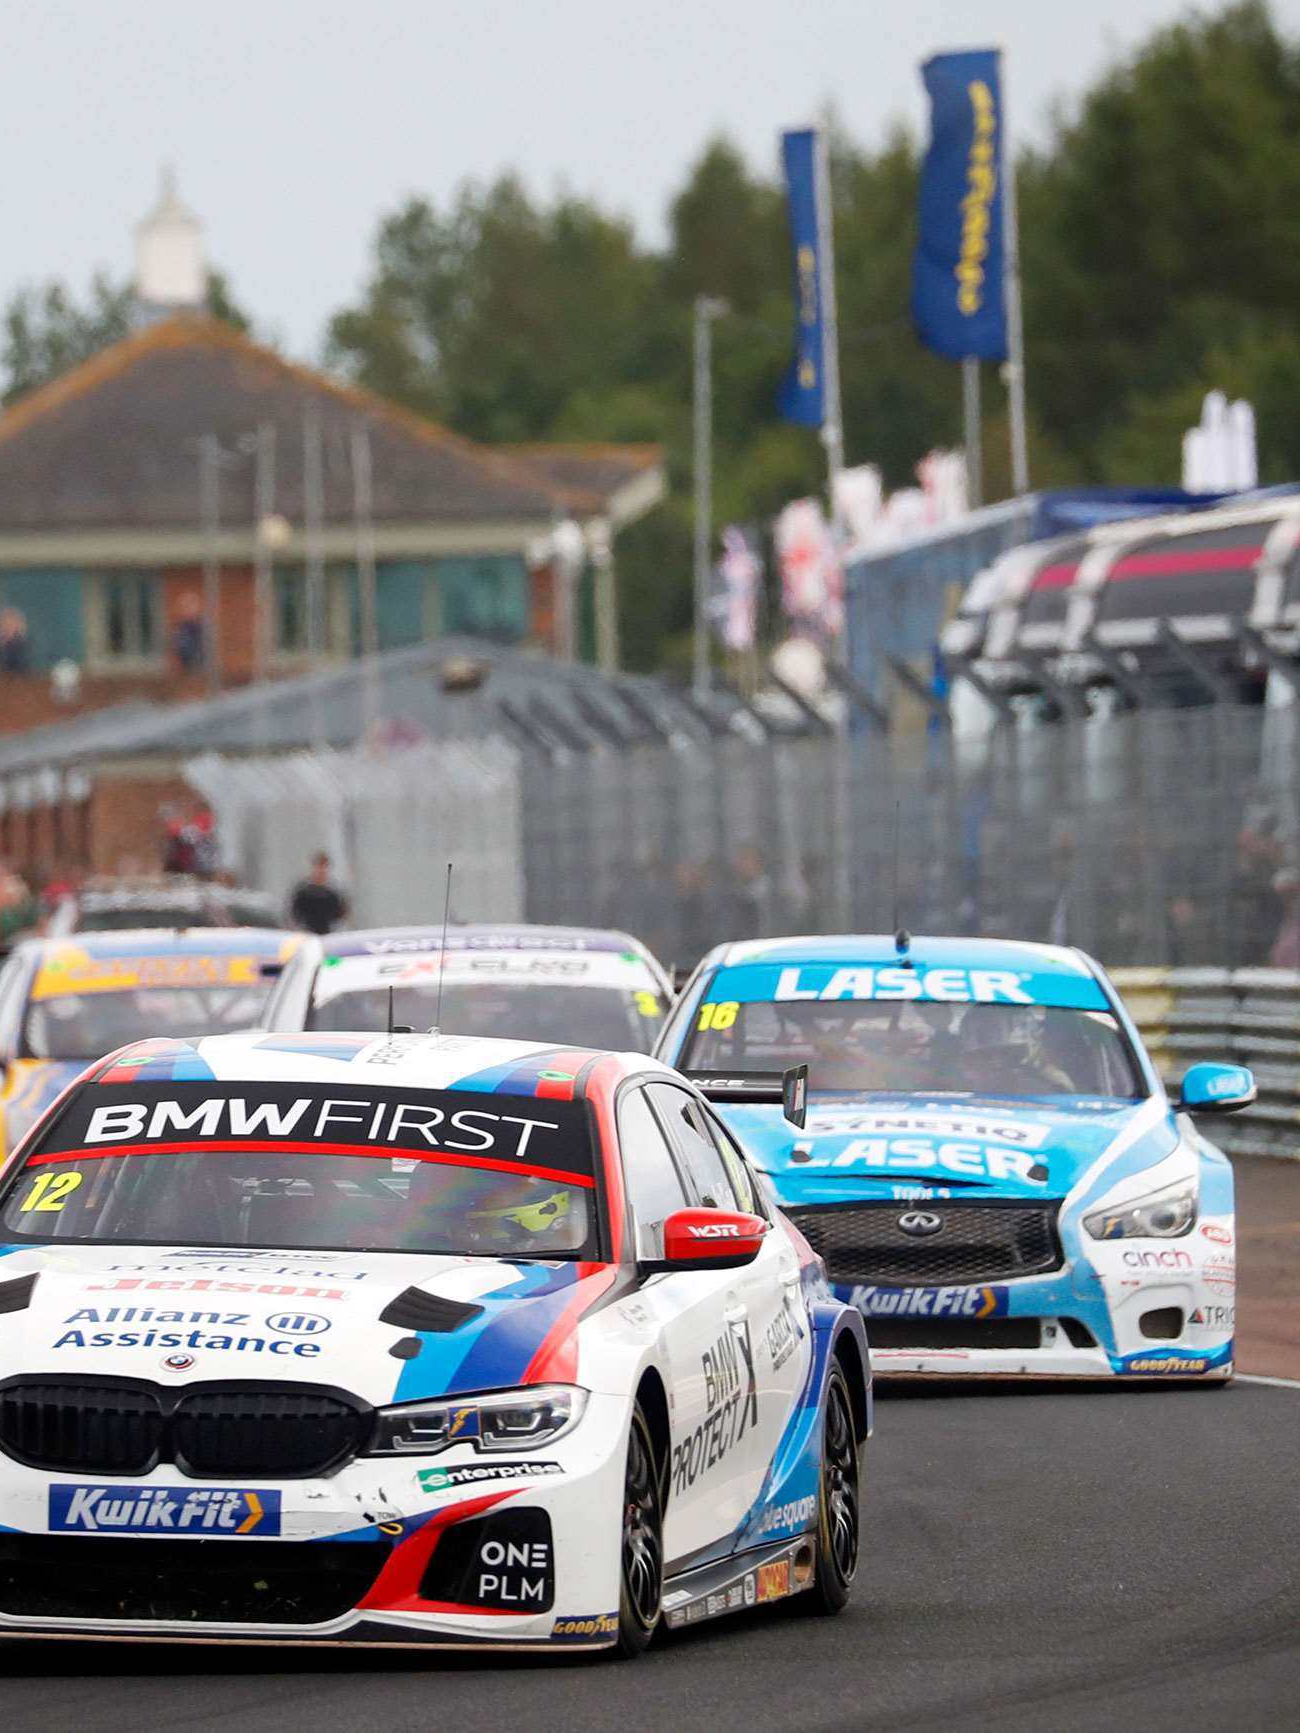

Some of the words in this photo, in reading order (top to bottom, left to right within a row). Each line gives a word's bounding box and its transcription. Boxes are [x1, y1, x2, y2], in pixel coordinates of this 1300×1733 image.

[774, 968, 1034, 1003] LASER
[698, 1001, 740, 1031] 16
[787, 1139, 1049, 1187] LASER
[20, 1171, 83, 1212] 12
[687, 1223, 741, 1237] WSR
[1123, 1249, 1193, 1267] cinch
[84, 1279, 349, 1300] Jelson
[63, 1307, 252, 1325] Allianz
[52, 1329, 322, 1358] Assistance
[672, 1390, 741, 1497] PROTECT
[421, 1463, 561, 1487] enterprise
[480, 1541, 549, 1568] ONE
[478, 1574, 545, 1601] PLM
